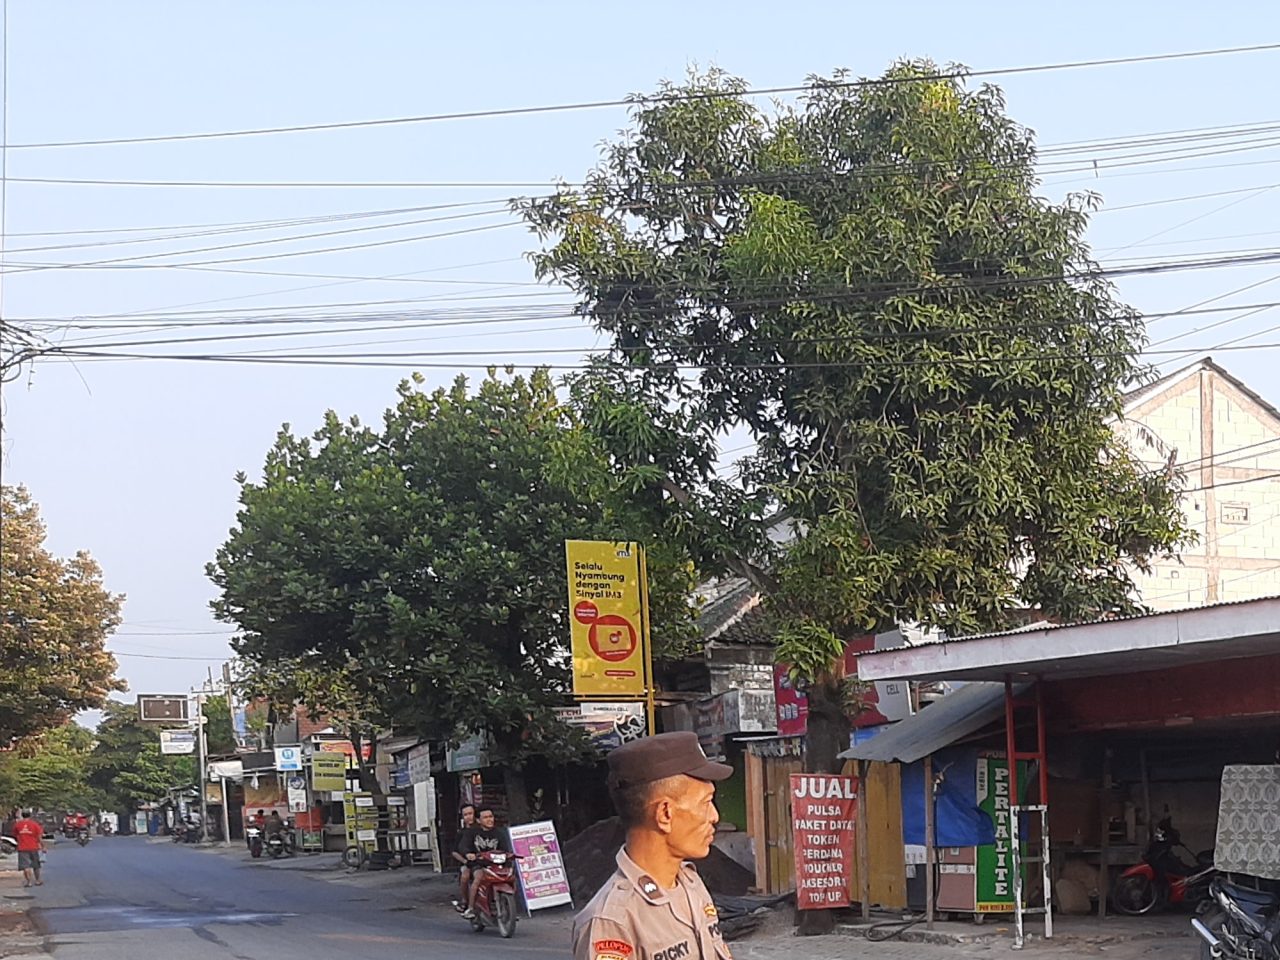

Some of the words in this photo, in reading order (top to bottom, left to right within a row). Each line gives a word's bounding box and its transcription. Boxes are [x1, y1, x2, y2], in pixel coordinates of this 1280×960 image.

[575, 561, 603, 571] Selalu
[575, 571, 625, 582] Nyambung
[575, 581, 611, 591] dengan
[576, 590, 604, 600] Sinyal
[794, 777, 857, 799] JUAL
[807, 804, 842, 815] PULSA
[994, 767, 1010, 896] PERTALITE
[807, 834, 840, 845] TOKEN
[808, 893, 825, 903] TOP
[827, 891, 842, 902] UP
